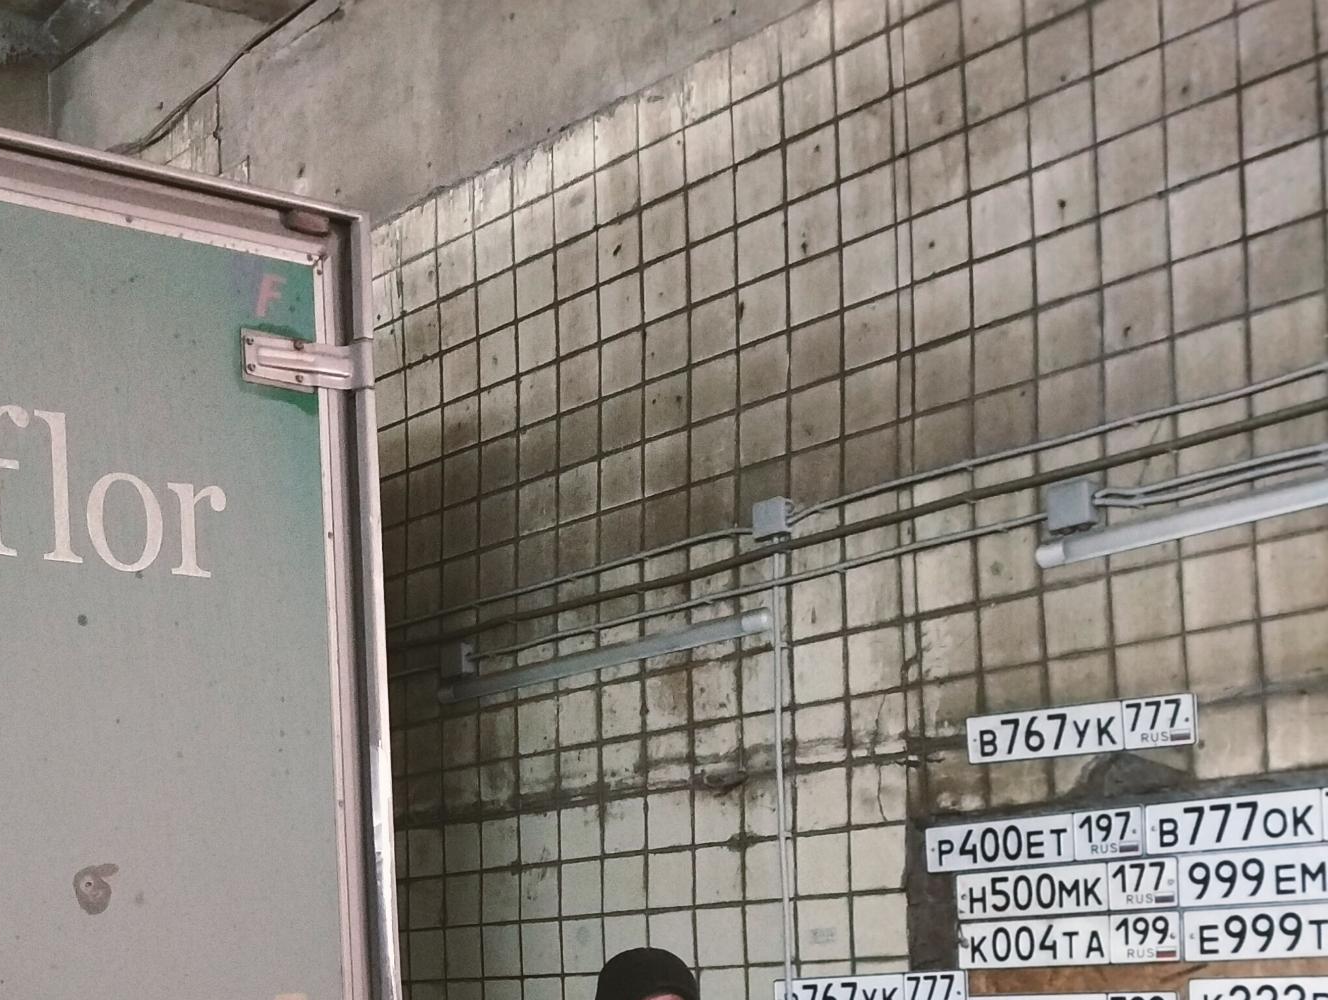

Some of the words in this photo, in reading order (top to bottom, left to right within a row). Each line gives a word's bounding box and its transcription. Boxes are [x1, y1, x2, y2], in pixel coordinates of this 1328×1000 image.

[979, 713, 1117, 757] В767УК
[1125, 698, 1181, 732] 777
[1140, 731, 1170, 742] RUS
[937, 824, 1067, 866] Р400ЕТ
[1079, 811, 1131, 843] 197
[1090, 843, 1118, 854] RUS
[969, 873, 1102, 914] Н500МК
[1112, 861, 1165, 893] 177
[1126, 893, 1153, 905] RUS
[971, 924, 1104, 963] К004ТА
[1115, 915, 1169, 945] 199
[1127, 948, 1154, 958] RUS
